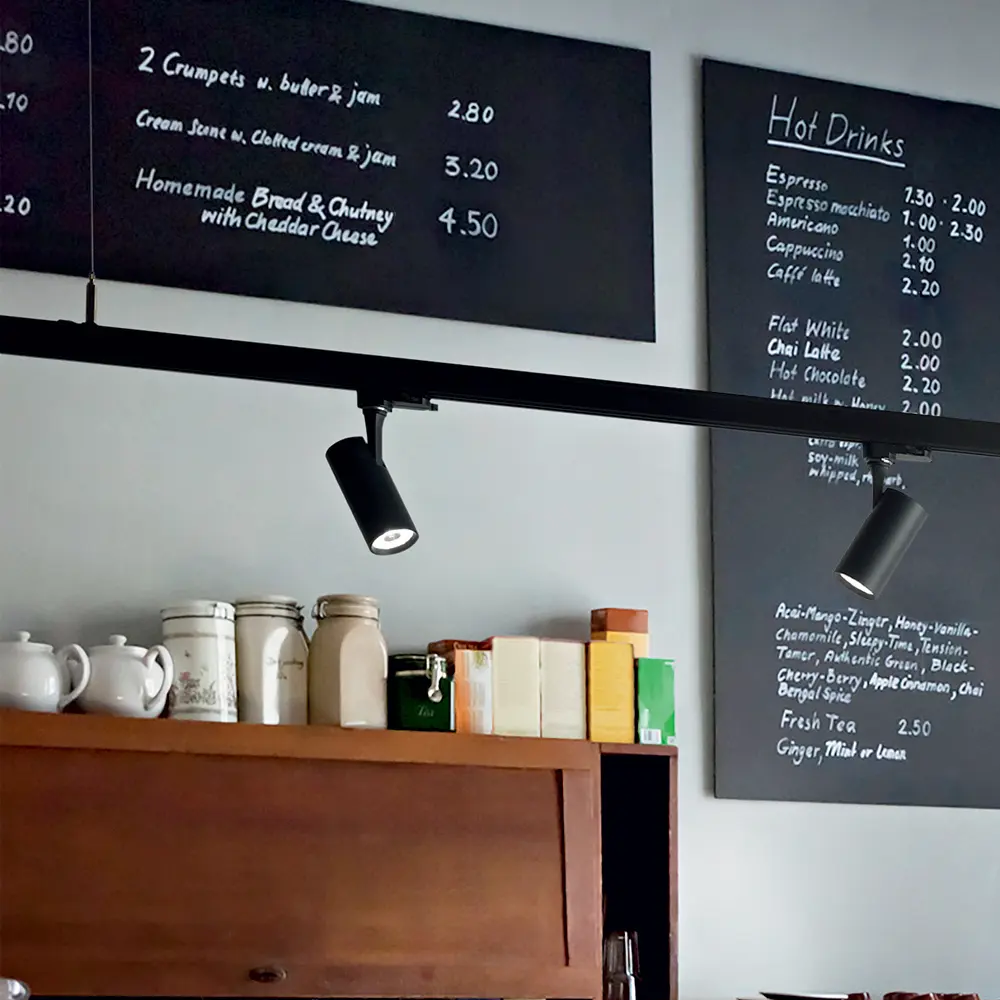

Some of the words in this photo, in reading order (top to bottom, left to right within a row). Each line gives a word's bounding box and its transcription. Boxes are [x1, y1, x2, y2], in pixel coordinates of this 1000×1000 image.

[138, 46, 155, 74] 2
[163, 51, 245, 88] Crumpets
[328, 84, 342, 104] &
[346, 81, 382, 107] jam
[447, 99, 495, 123] 2.80
[768, 93, 818, 141] Hot
[826, 112, 905, 158] Drinks
[136, 108, 183, 132] Cream
[187, 118, 226, 140] Scone
[301, 141, 343, 158] cream
[347, 145, 360, 162] &
[360, 143, 397, 169] jam
[444, 155, 498, 180] 3.20
[135, 168, 245, 204] Homemade
[251, 186, 307, 213] Bread
[307, 194, 326, 220] &
[328, 196, 394, 233] Chutney
[438, 207, 498, 239] 4.50
[766, 164, 828, 192] Espresso
[904, 186, 934, 208] 1.30
[952, 194, 986, 216] 2.00
[201, 206, 242, 228] with
[244, 212, 320, 236] Cheddar
[766, 188, 828, 213] Espresso
[903, 210, 936, 232] 1.00
[950, 221, 983, 243] 2.30
[767, 212, 839, 235] Americano
[903, 235, 936, 253] 1.00
[766, 235, 844, 261] Cappuccino
[902, 253, 935, 273] 2.10
[811, 268, 841, 288] latte
[902, 277, 940, 297] 2.20
[768, 315, 798, 333] Flat
[805, 319, 850, 340] White
[902, 329, 942, 349] 2.00
[767, 338, 799, 357] Chai
[804, 341, 841, 362] Latte
[900, 353, 941, 372] 2.00
[770, 360, 798, 380] Hot
[804, 365, 867, 389] Chocolate
[902, 375, 941, 395] 2.20
[902, 400, 941, 416] 2.00
[778, 682, 820, 704] Bengal
[822, 688, 851, 704] Spice
[959, 682, 984, 697] Chai
[780, 709, 820, 731] Fresh
[826, 713, 857, 733] Tea
[898, 719, 931, 737] 2.50
[777, 737, 822, 766] Ginger,
[825, 741, 857, 757] Mint
[860, 748, 873, 758] or
